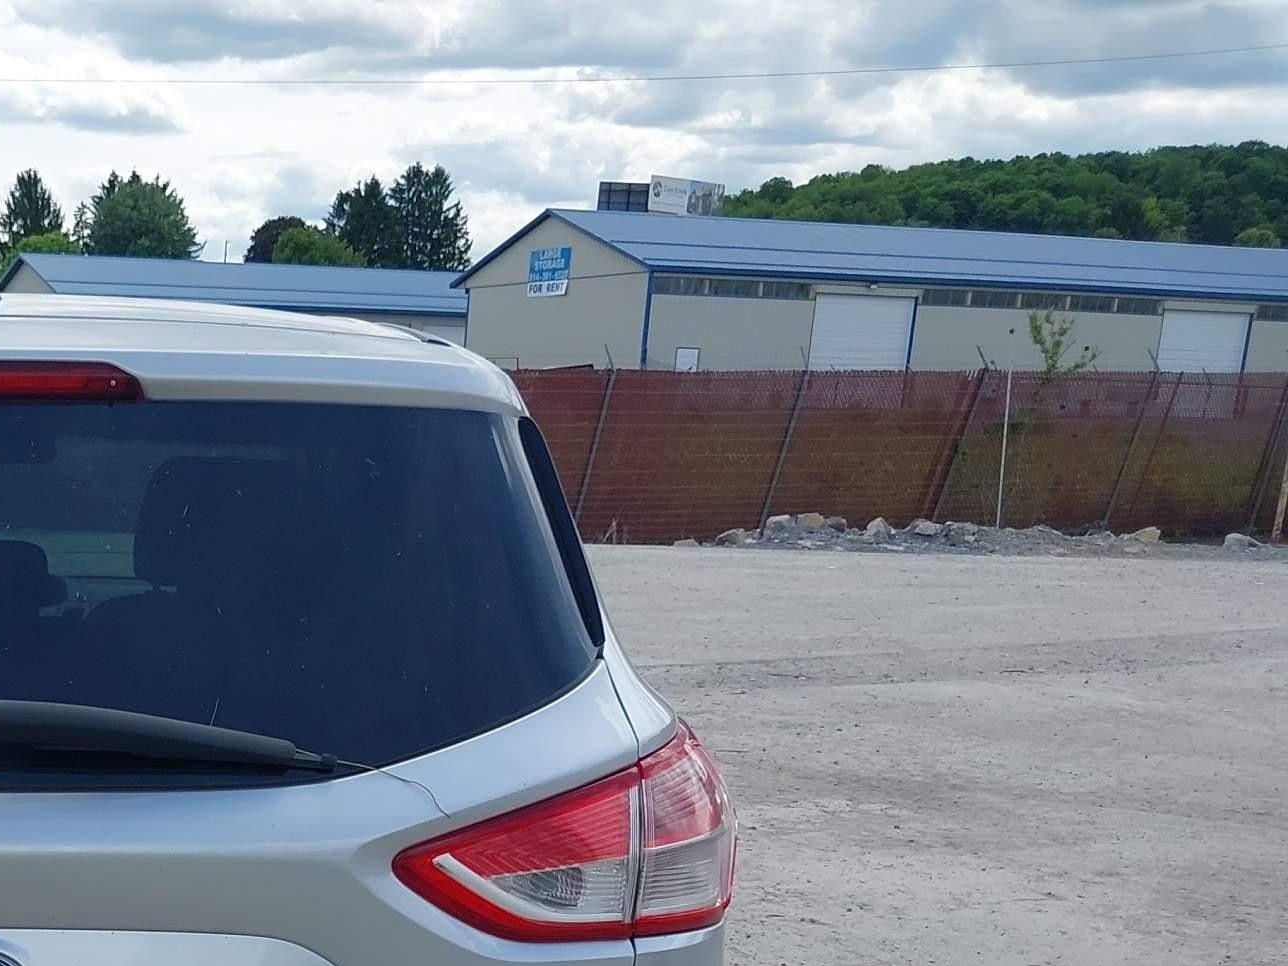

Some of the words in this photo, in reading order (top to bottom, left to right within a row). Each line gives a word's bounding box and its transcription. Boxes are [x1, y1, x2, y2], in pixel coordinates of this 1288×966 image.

[539, 248, 562, 260] LARGE
[534, 258, 565, 271] STORAGE
[529, 283, 543, 294] FOR
[546, 281, 565, 293] RENT
